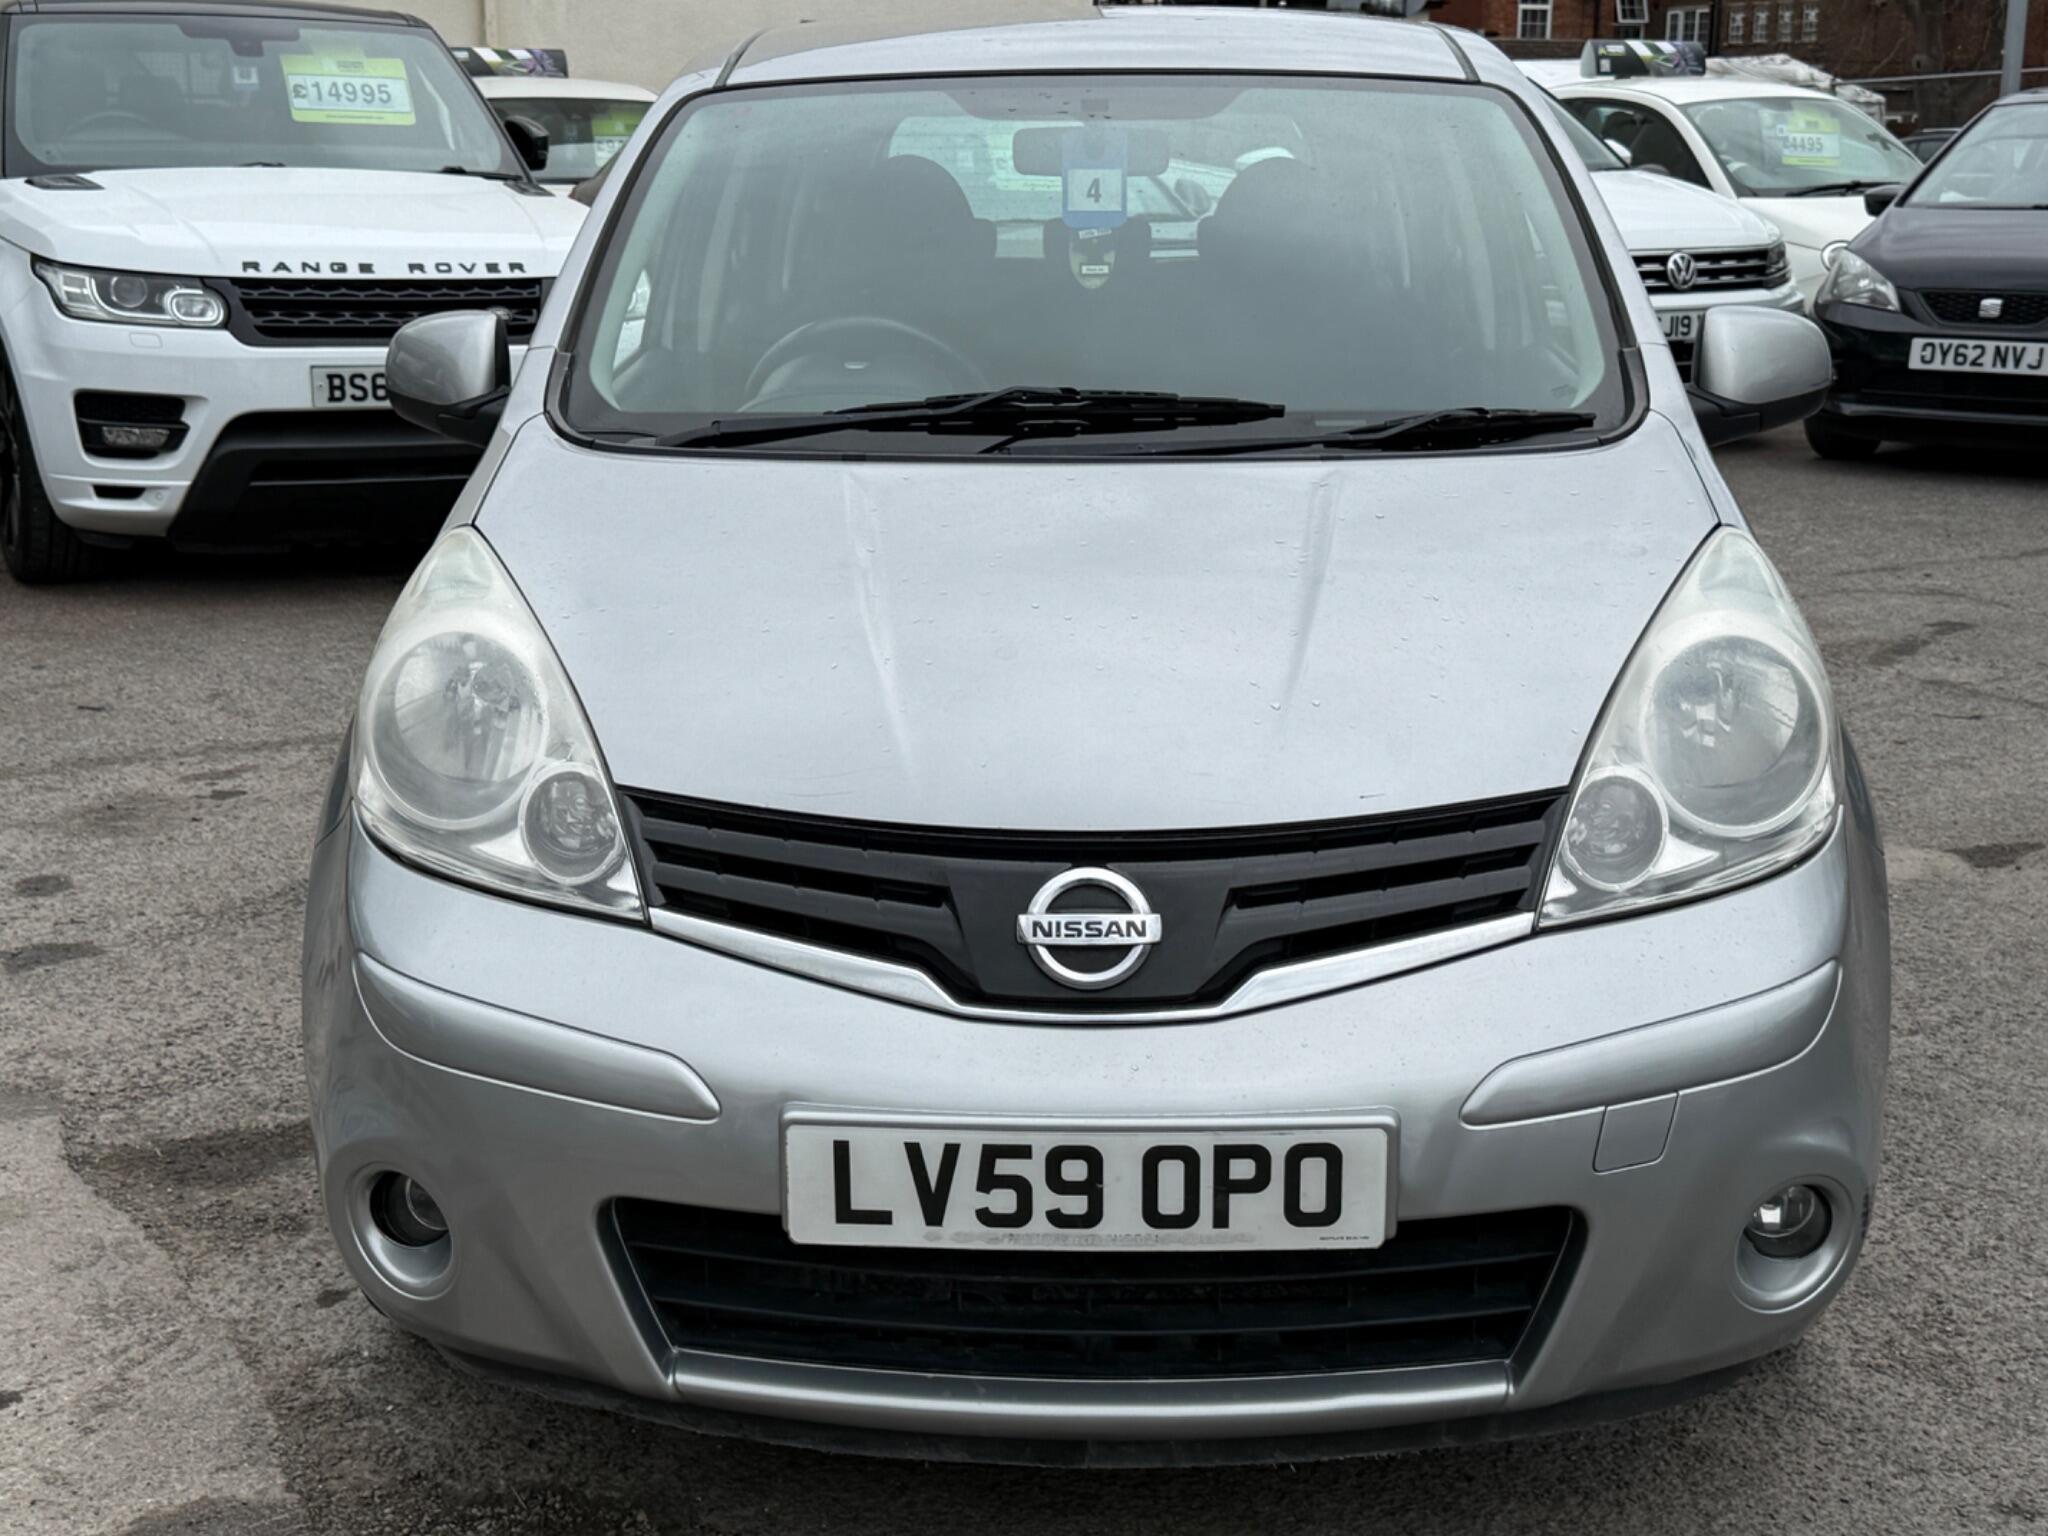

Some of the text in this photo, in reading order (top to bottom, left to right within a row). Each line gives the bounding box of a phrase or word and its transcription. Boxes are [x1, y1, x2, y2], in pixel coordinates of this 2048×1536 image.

[292, 81, 392, 104] £14995
[1086, 177, 1102, 204] 4
[242, 261, 527, 274] RANGE ROVER
[1658, 314, 1692, 338] J19
[1920, 341, 2045, 371] OY62 NVJ
[1031, 919, 1147, 938] NISSAN
[831, 1139, 1344, 1230] LV59 OPO
